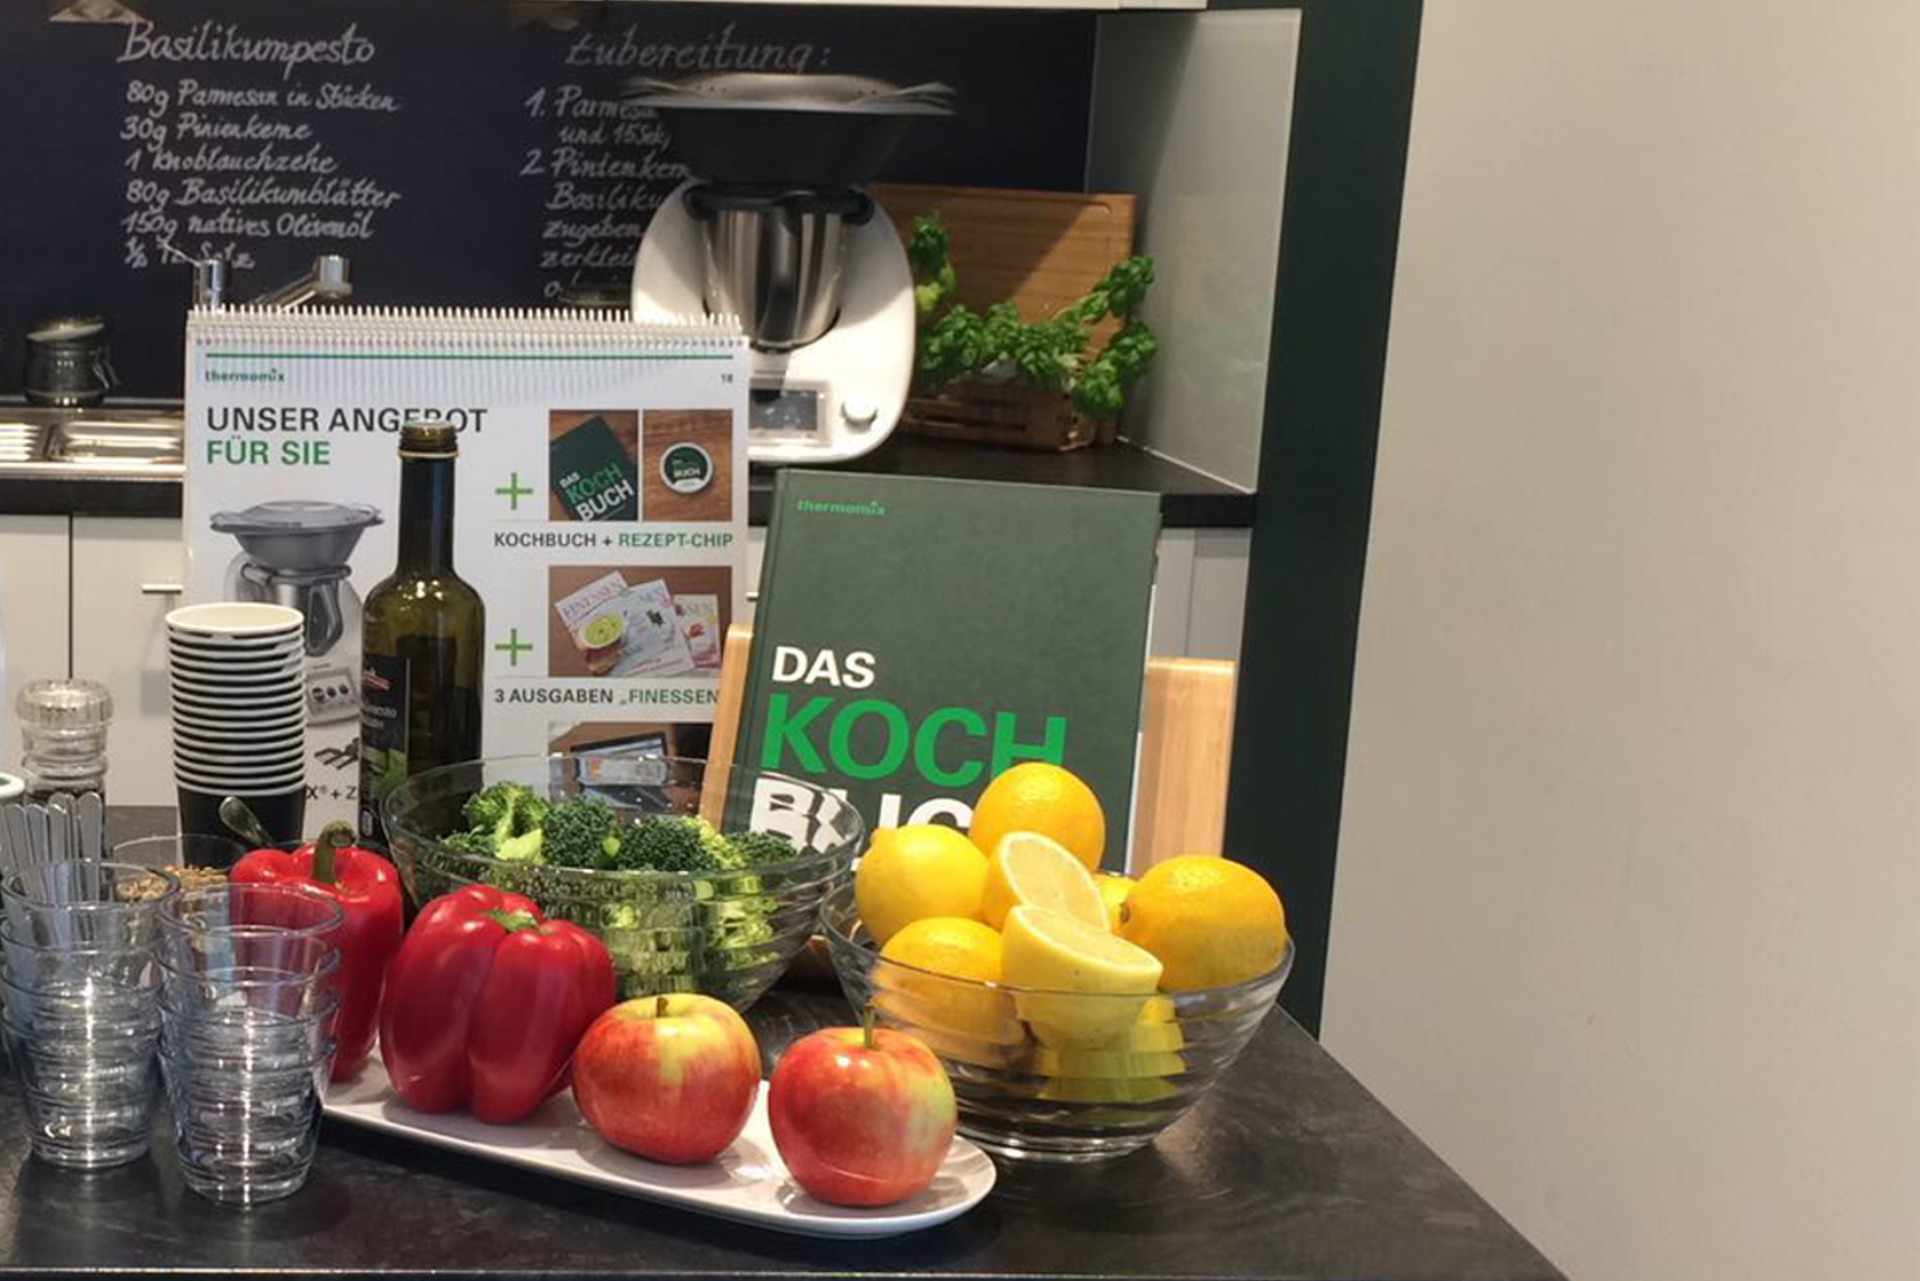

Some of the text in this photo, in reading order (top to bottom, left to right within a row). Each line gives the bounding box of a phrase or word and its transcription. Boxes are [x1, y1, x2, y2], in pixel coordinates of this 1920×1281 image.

[116, 18, 375, 80] Basilikumpesto
[126, 79, 170, 118] 80g
[177, 78, 279, 106] Parmesan
[286, 84, 312, 107] in
[525, 84, 660, 118] 1. Parmesa
[119, 114, 168, 151] 30g
[558, 121, 608, 144] und
[124, 143, 338, 174] 1 Knoblauchzehe
[126, 177, 401, 214] 80g Basilikumblätter
[121, 208, 375, 247] 150g natives Olivenöl
[540, 242, 638, 268] zerklei
[207, 407, 319, 432] UNSER
[207, 435, 330, 465] FÜR SIE
[565, 462, 623, 504] KOCH
[575, 479, 635, 521] BUCH
[494, 532, 597, 548] KOCHBUCH
[618, 532, 733, 548] REZEPT-CHIP
[772, 646, 876, 689] DAS
[494, 688, 505, 704] 3
[509, 688, 613, 704] AUSGABEN
[760, 693, 1067, 788] KOCH
